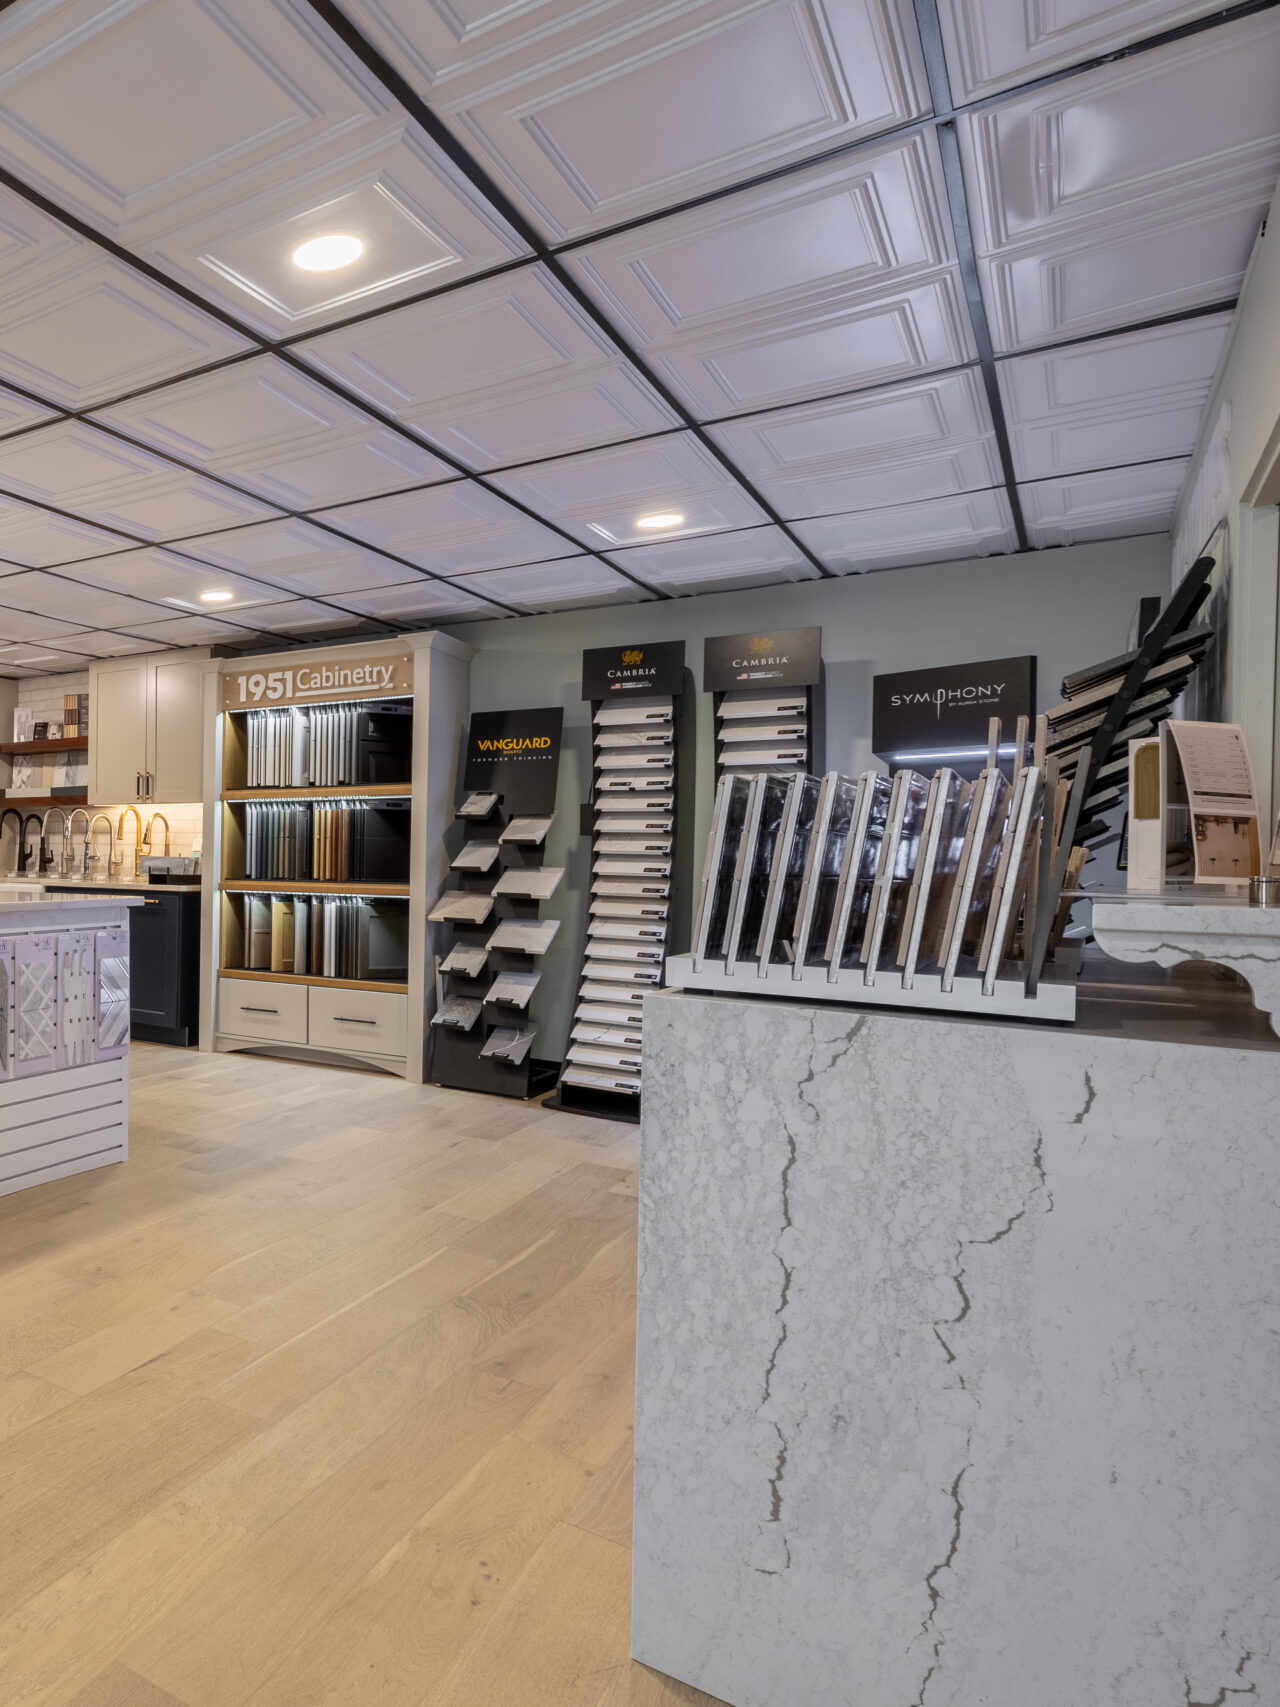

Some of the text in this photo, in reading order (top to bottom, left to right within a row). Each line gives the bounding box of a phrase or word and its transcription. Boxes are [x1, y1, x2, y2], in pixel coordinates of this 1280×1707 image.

[732, 656, 789, 668] CAMBRIA
[607, 667, 657, 678] CAMBRIA
[237, 665, 394, 702] 1951 Cabinetry
[891, 683, 1006, 720] SYMPHONY
[477, 736, 551, 751] VANGUARD
